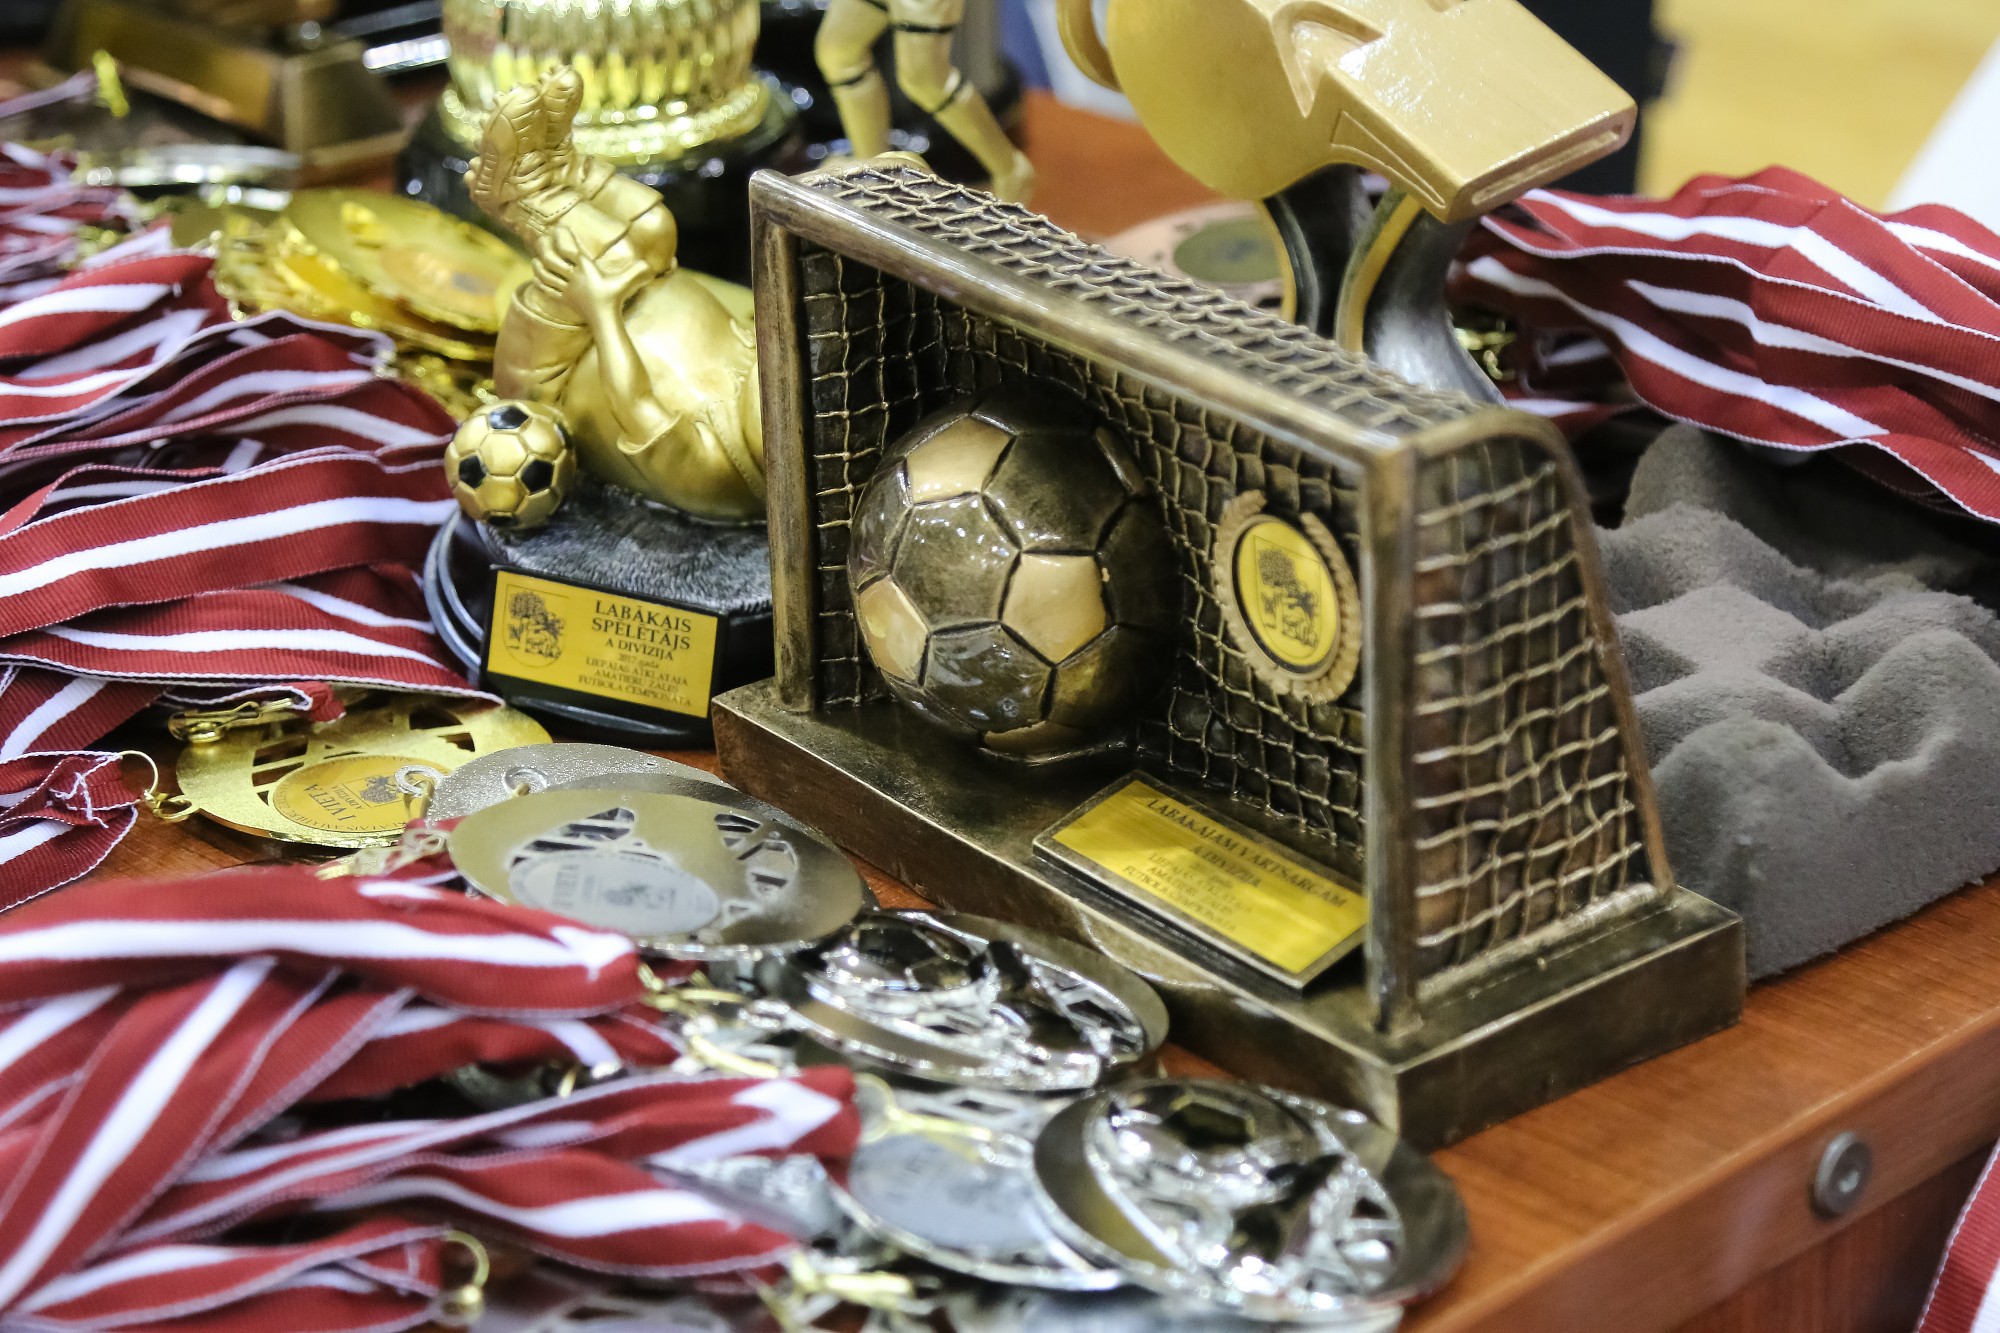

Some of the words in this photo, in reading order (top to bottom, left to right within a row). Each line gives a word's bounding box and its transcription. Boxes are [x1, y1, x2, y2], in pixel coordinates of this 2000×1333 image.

[595, 600, 691, 632] LABĀKAIS
[605, 638, 614, 648] A
[304, 784, 346, 815] VIETA
